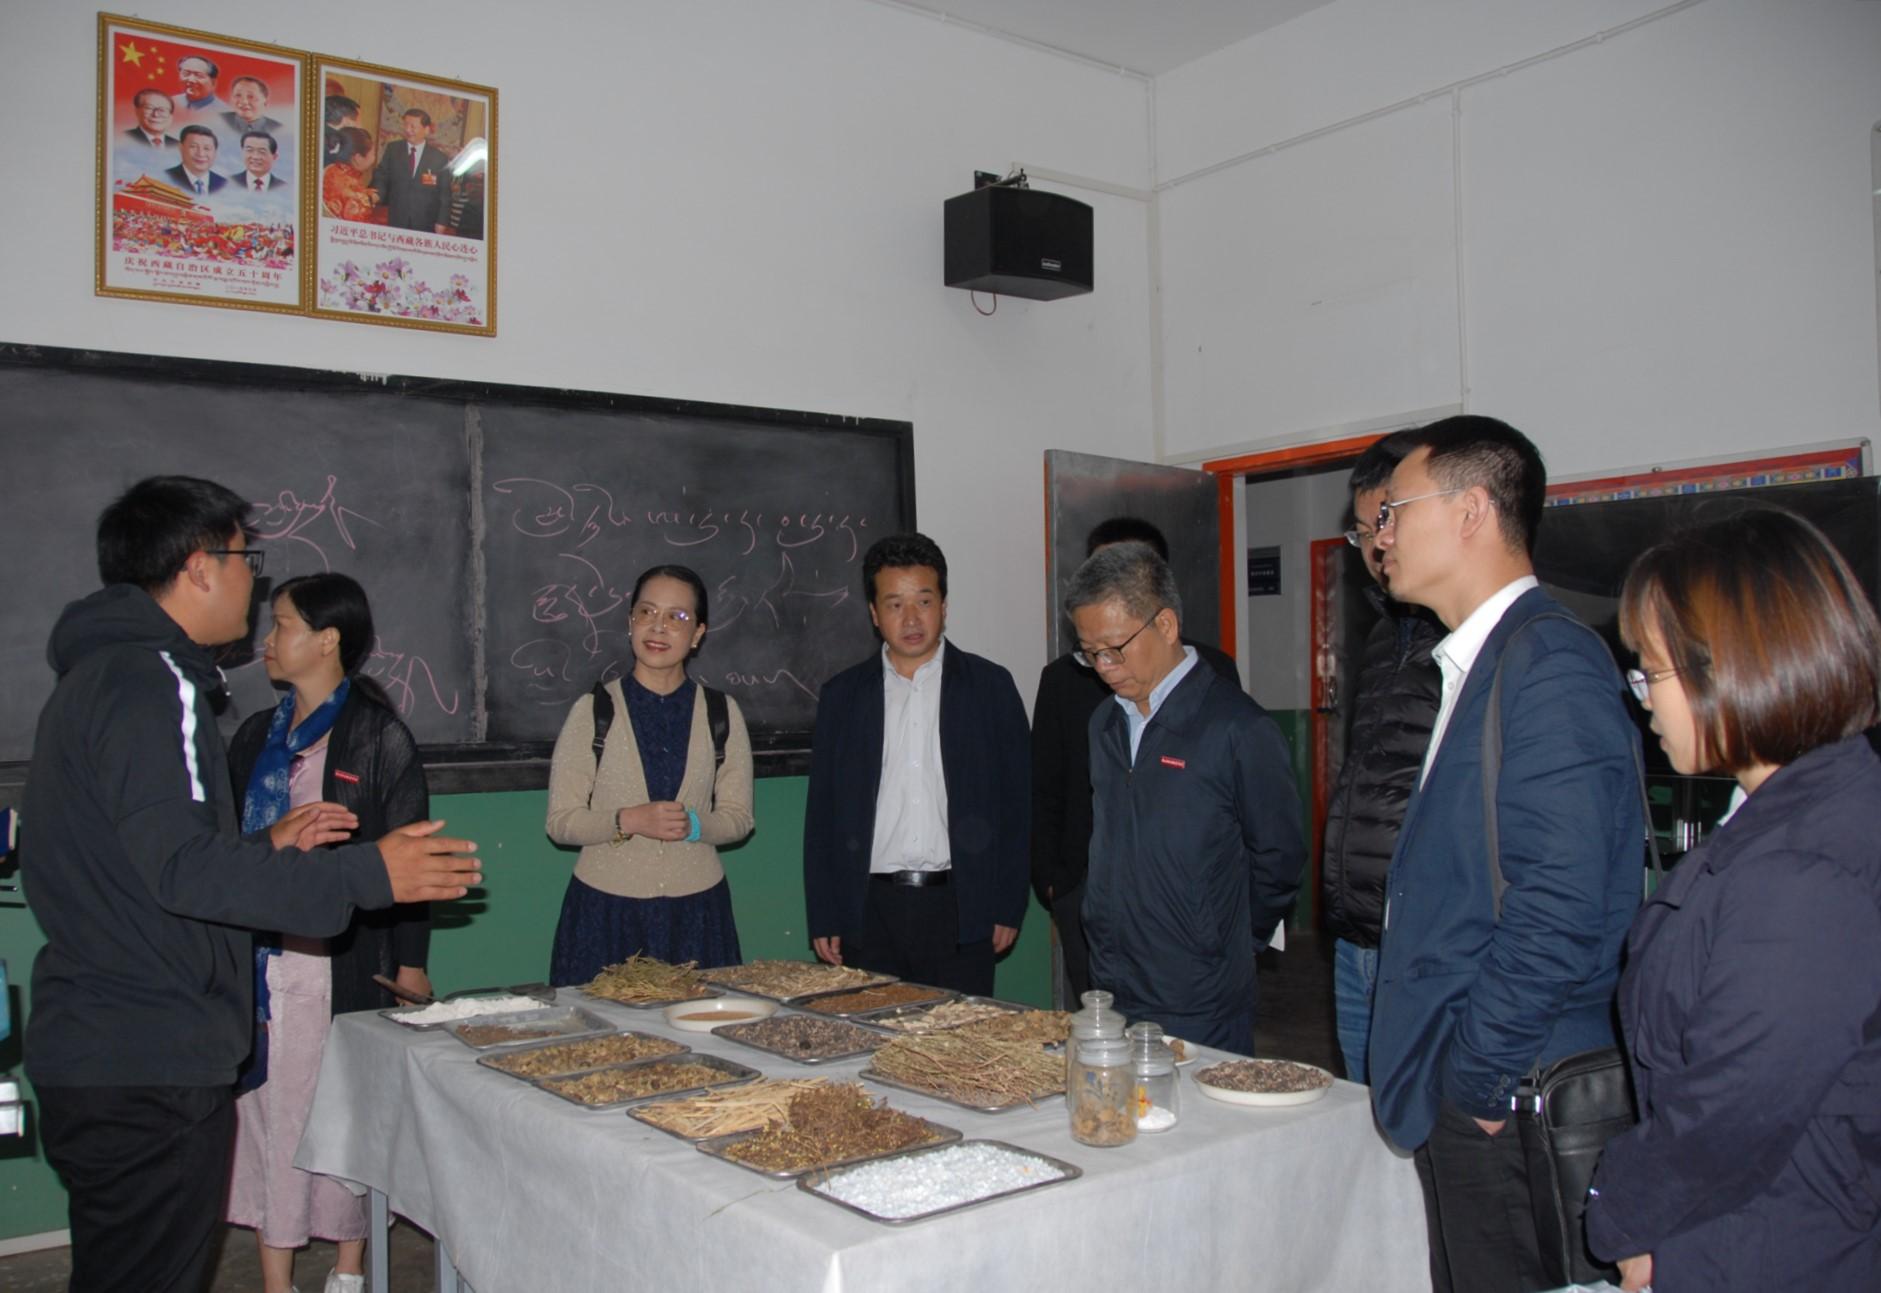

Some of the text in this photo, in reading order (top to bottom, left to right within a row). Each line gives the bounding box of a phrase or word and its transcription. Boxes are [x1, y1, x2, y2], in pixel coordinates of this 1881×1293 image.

[330, 225, 478, 255] 习近平总书记与西藏各族人民心连心
[124, 257, 282, 281] 庆祝西藏自治区成立五十周年
